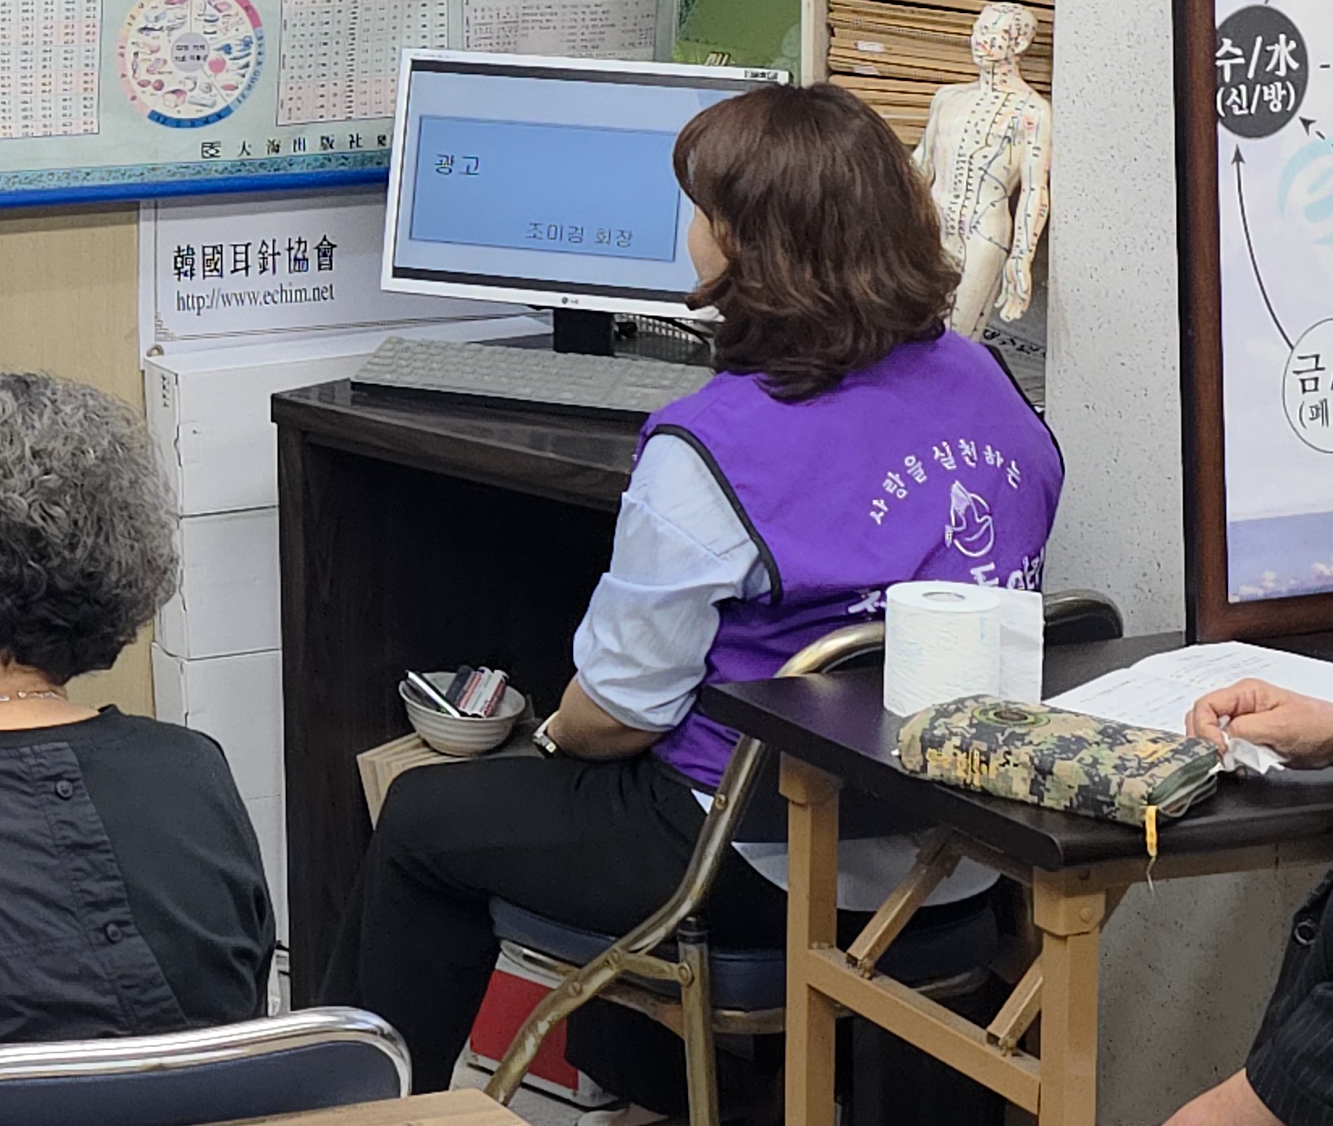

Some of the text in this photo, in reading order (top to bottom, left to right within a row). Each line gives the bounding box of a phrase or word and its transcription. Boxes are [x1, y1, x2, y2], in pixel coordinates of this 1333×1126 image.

[1214, 33, 1300, 83] 수/水
[1215, 80, 1296, 118] (신/방)
[525, 221, 634, 248] 조미경 회장
[172, 232, 339, 284] 韓國耳針協會
[175, 283, 336, 314] http://www.echim.net
[868, 437, 1023, 526] 사랑을 실천하는
